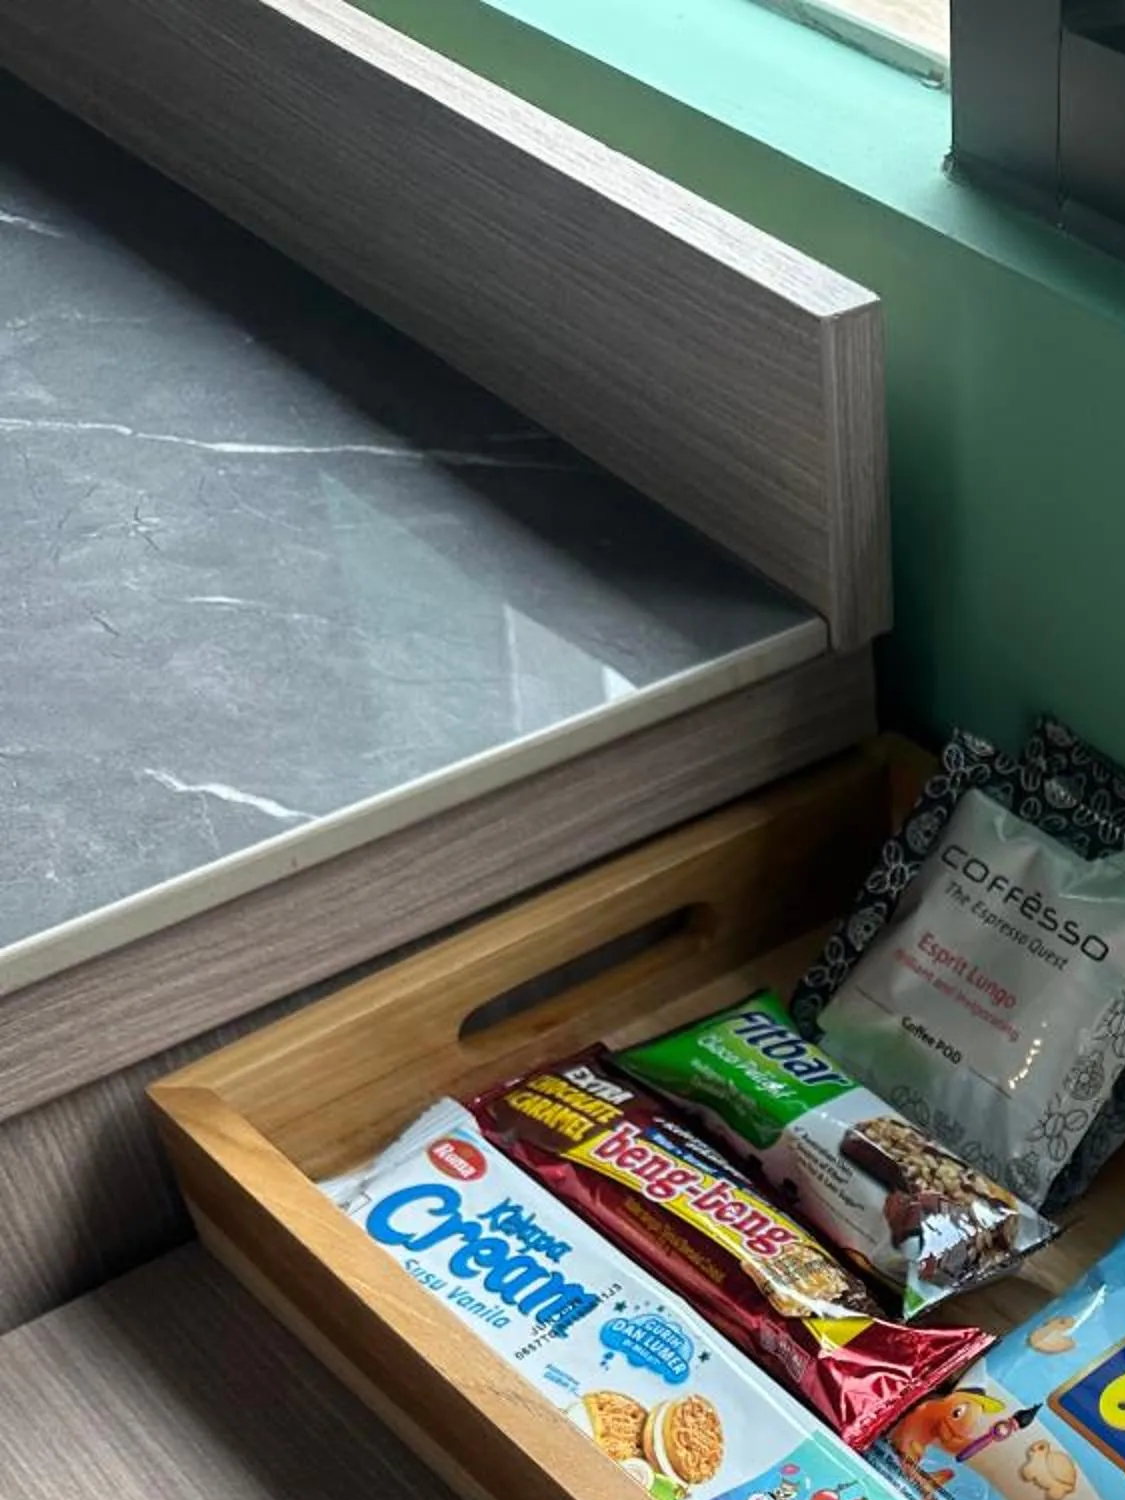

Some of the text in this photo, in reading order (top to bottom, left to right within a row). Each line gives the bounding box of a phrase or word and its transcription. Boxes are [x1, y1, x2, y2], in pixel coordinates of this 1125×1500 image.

[944, 881, 1070, 972] The Espresso Quest
[917, 930, 1017, 1009] Esprit Lungo
[901, 1015, 962, 1065] Coffee POD
[563, 1065, 634, 1105] EXTRA
[593, 1121, 798, 1258] beng-beng
[366, 1183, 600, 1337] Cream
[478, 1197, 573, 1264] Kelapa
[404, 1257, 513, 1330] Susu Vanila
[612, 1319, 688, 1376] DAN LUMER
